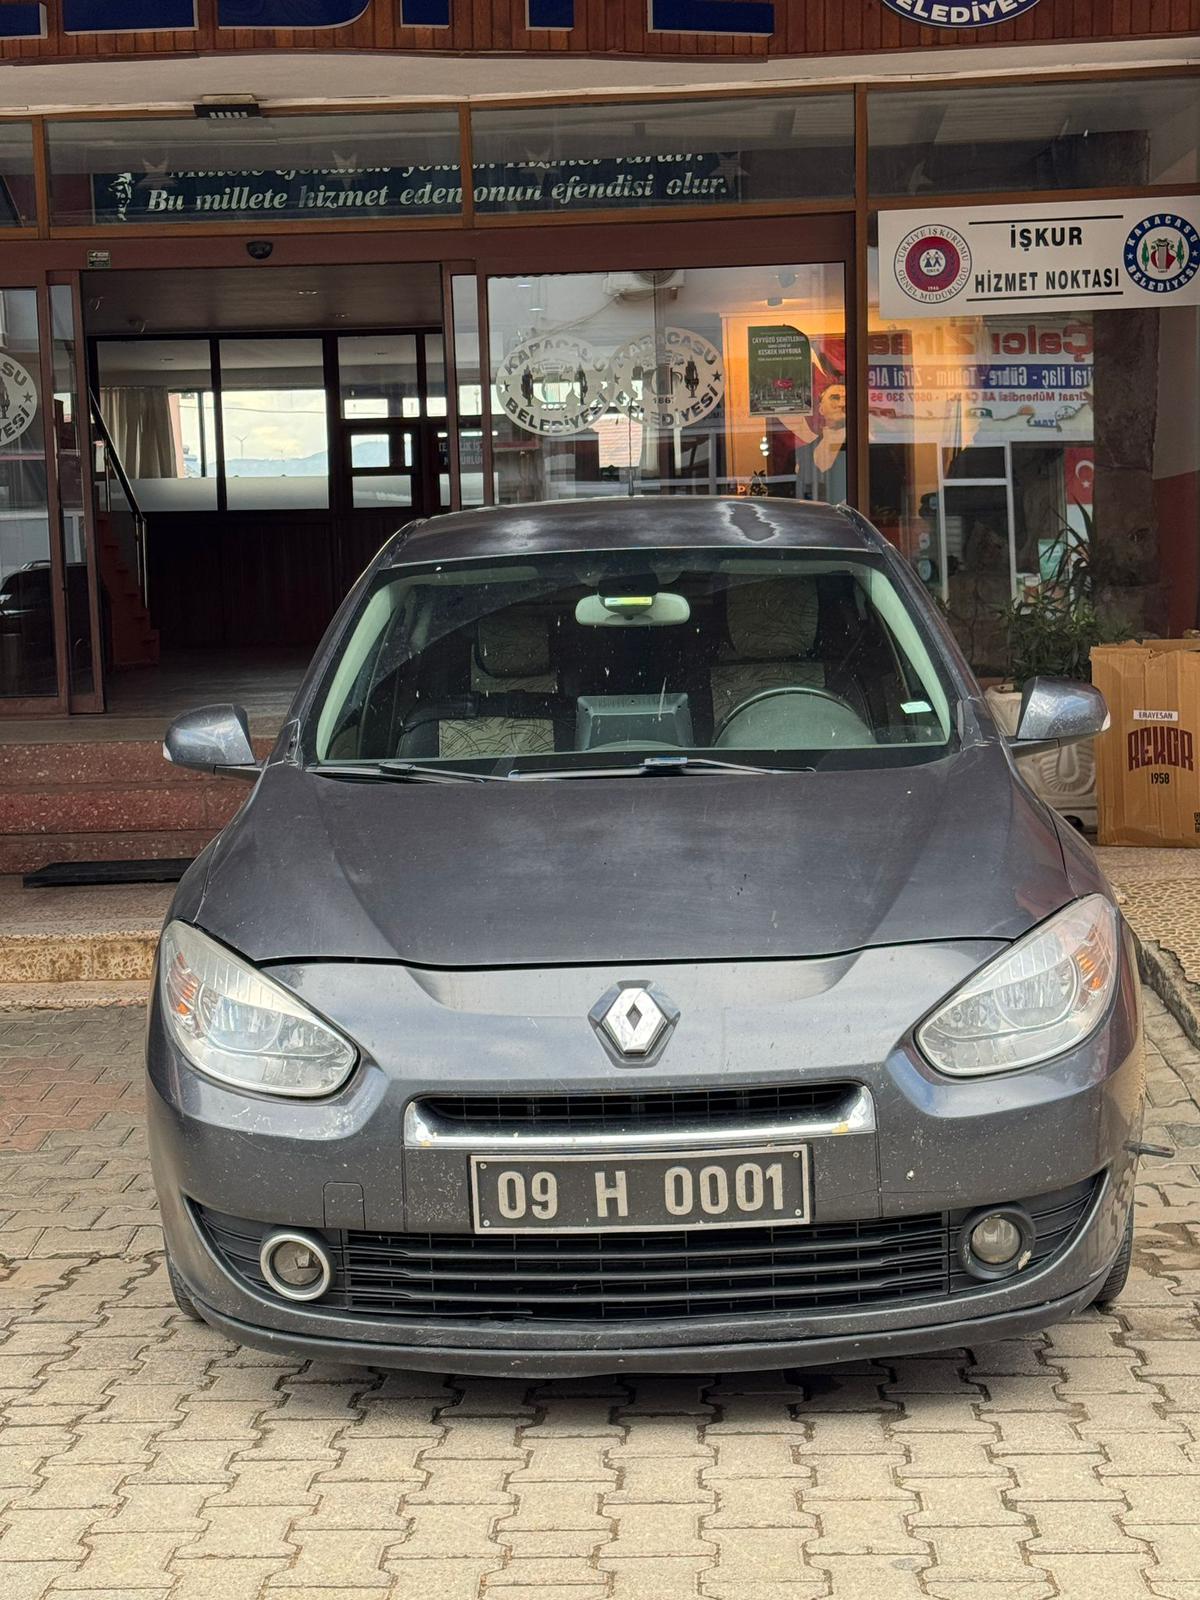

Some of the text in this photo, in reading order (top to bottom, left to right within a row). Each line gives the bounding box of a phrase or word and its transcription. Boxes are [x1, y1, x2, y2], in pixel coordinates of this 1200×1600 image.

[146, 172, 727, 212] Bu millete hizmet eden onun efendisi olur.
[1011, 225, 1083, 251] İŞKUR
[1127, 215, 1198, 246] KARACASU
[898, 269, 918, 297] GENEL
[975, 268, 1119, 293] HİZMET NOKTASI
[1128, 262, 1198, 292] BELEDİYESİ
[1127, 726, 1194, 772] REKOR
[1151, 772, 1170, 785] 1958
[497, 1162, 784, 1220] 09 H 0001
